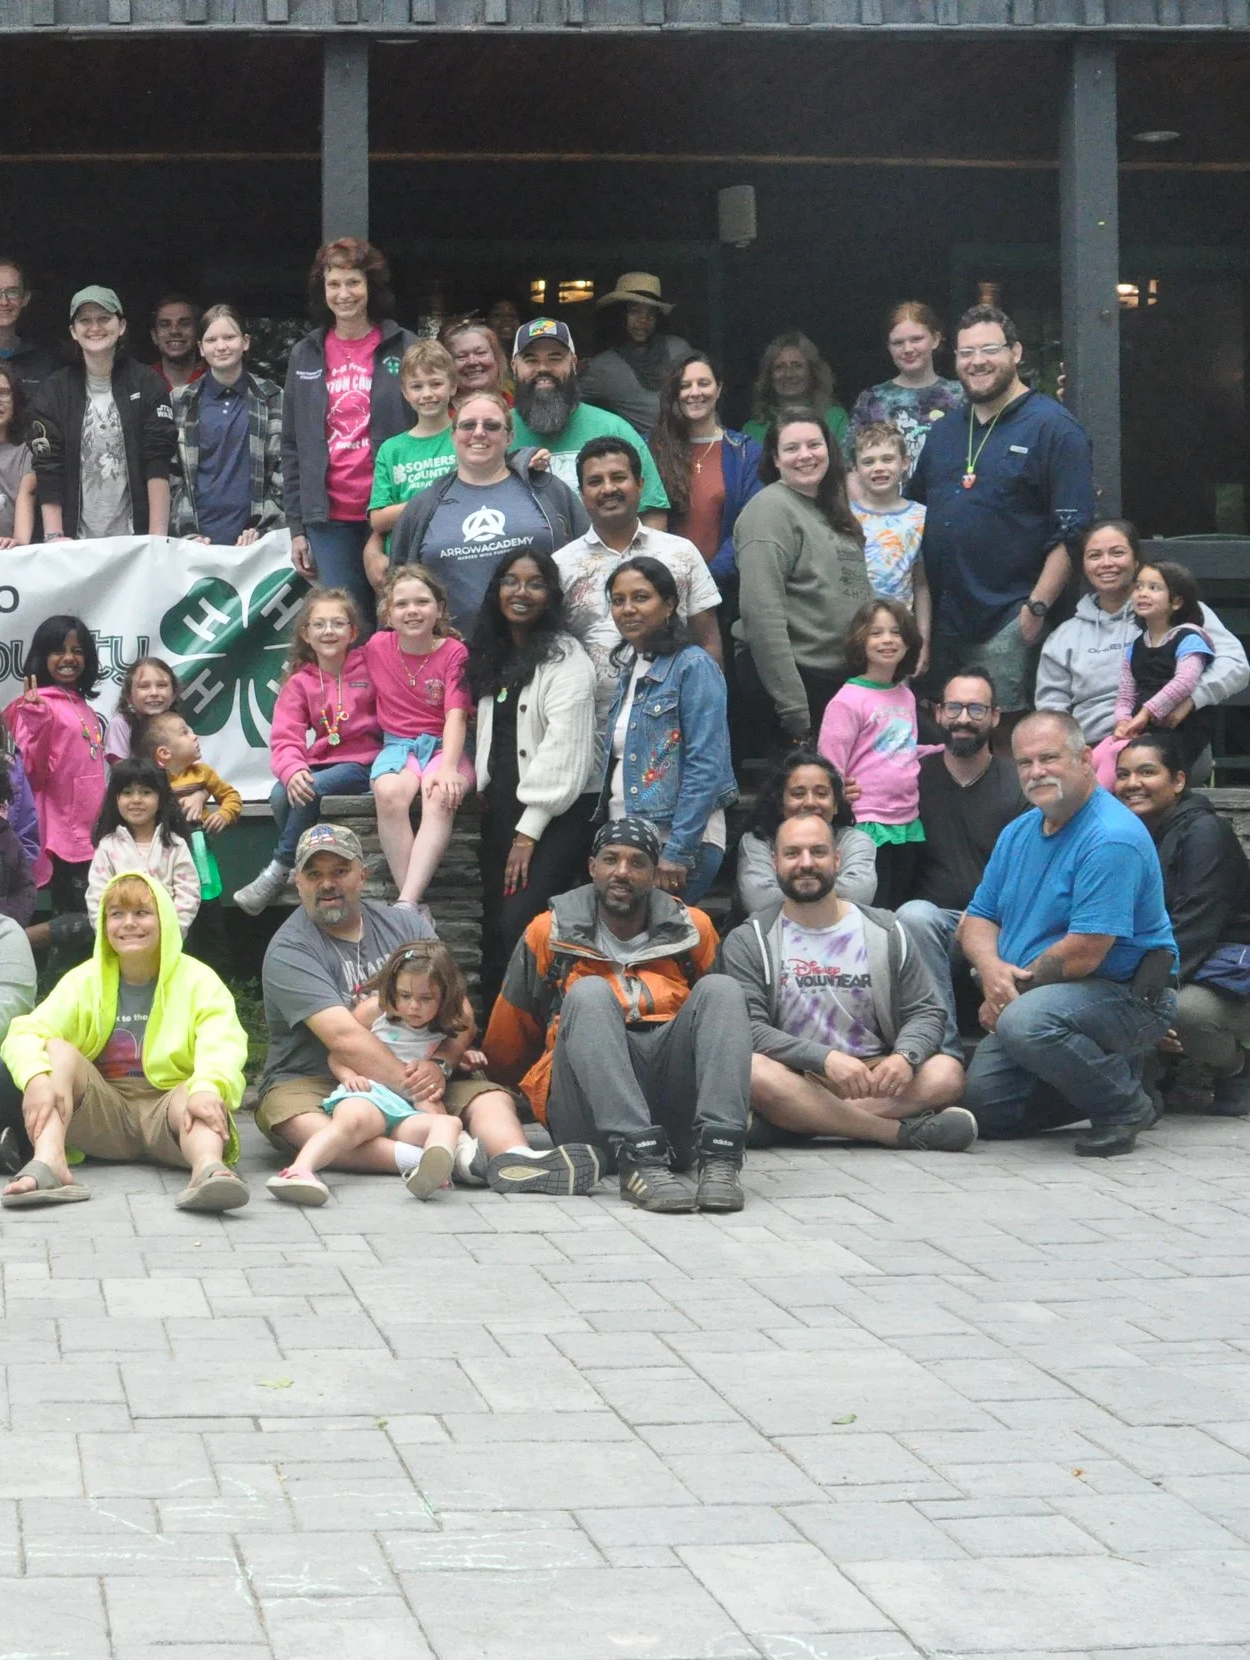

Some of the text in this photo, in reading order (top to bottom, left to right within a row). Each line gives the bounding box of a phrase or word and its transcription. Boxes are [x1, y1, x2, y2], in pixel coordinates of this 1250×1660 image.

[406, 454, 458, 473] SOMERS
[788, 958, 841, 977] Disney
[121, 1014, 131, 1022] to
[636, 1140, 657, 1148] adidas
[713, 1138, 734, 1147] adidas
